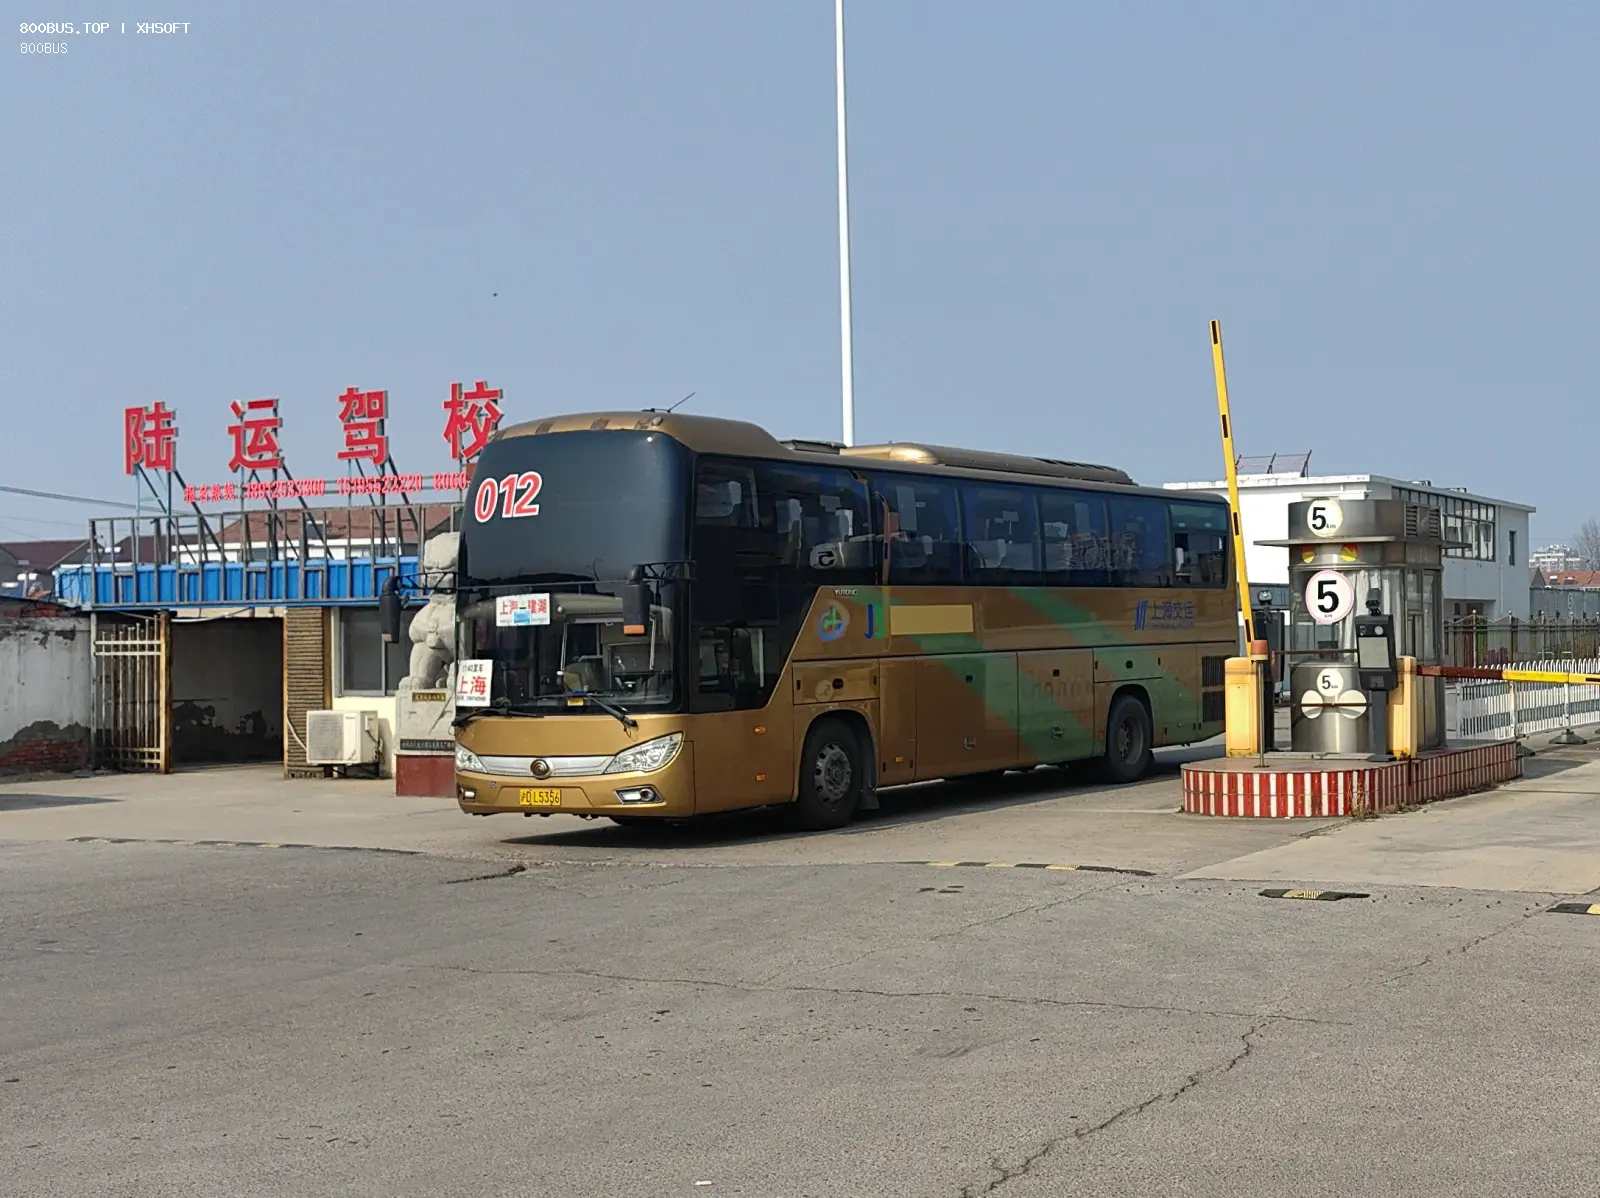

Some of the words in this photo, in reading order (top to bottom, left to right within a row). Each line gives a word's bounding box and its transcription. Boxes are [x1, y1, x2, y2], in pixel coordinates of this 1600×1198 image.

[124, 379, 504, 475] 陆运驾校
[475, 471, 542, 523] 012
[1312, 507, 1326, 530] 5
[1317, 580, 1339, 613] 5
[457, 675, 487, 695] 上海
[1322, 675, 1331, 690] 5
